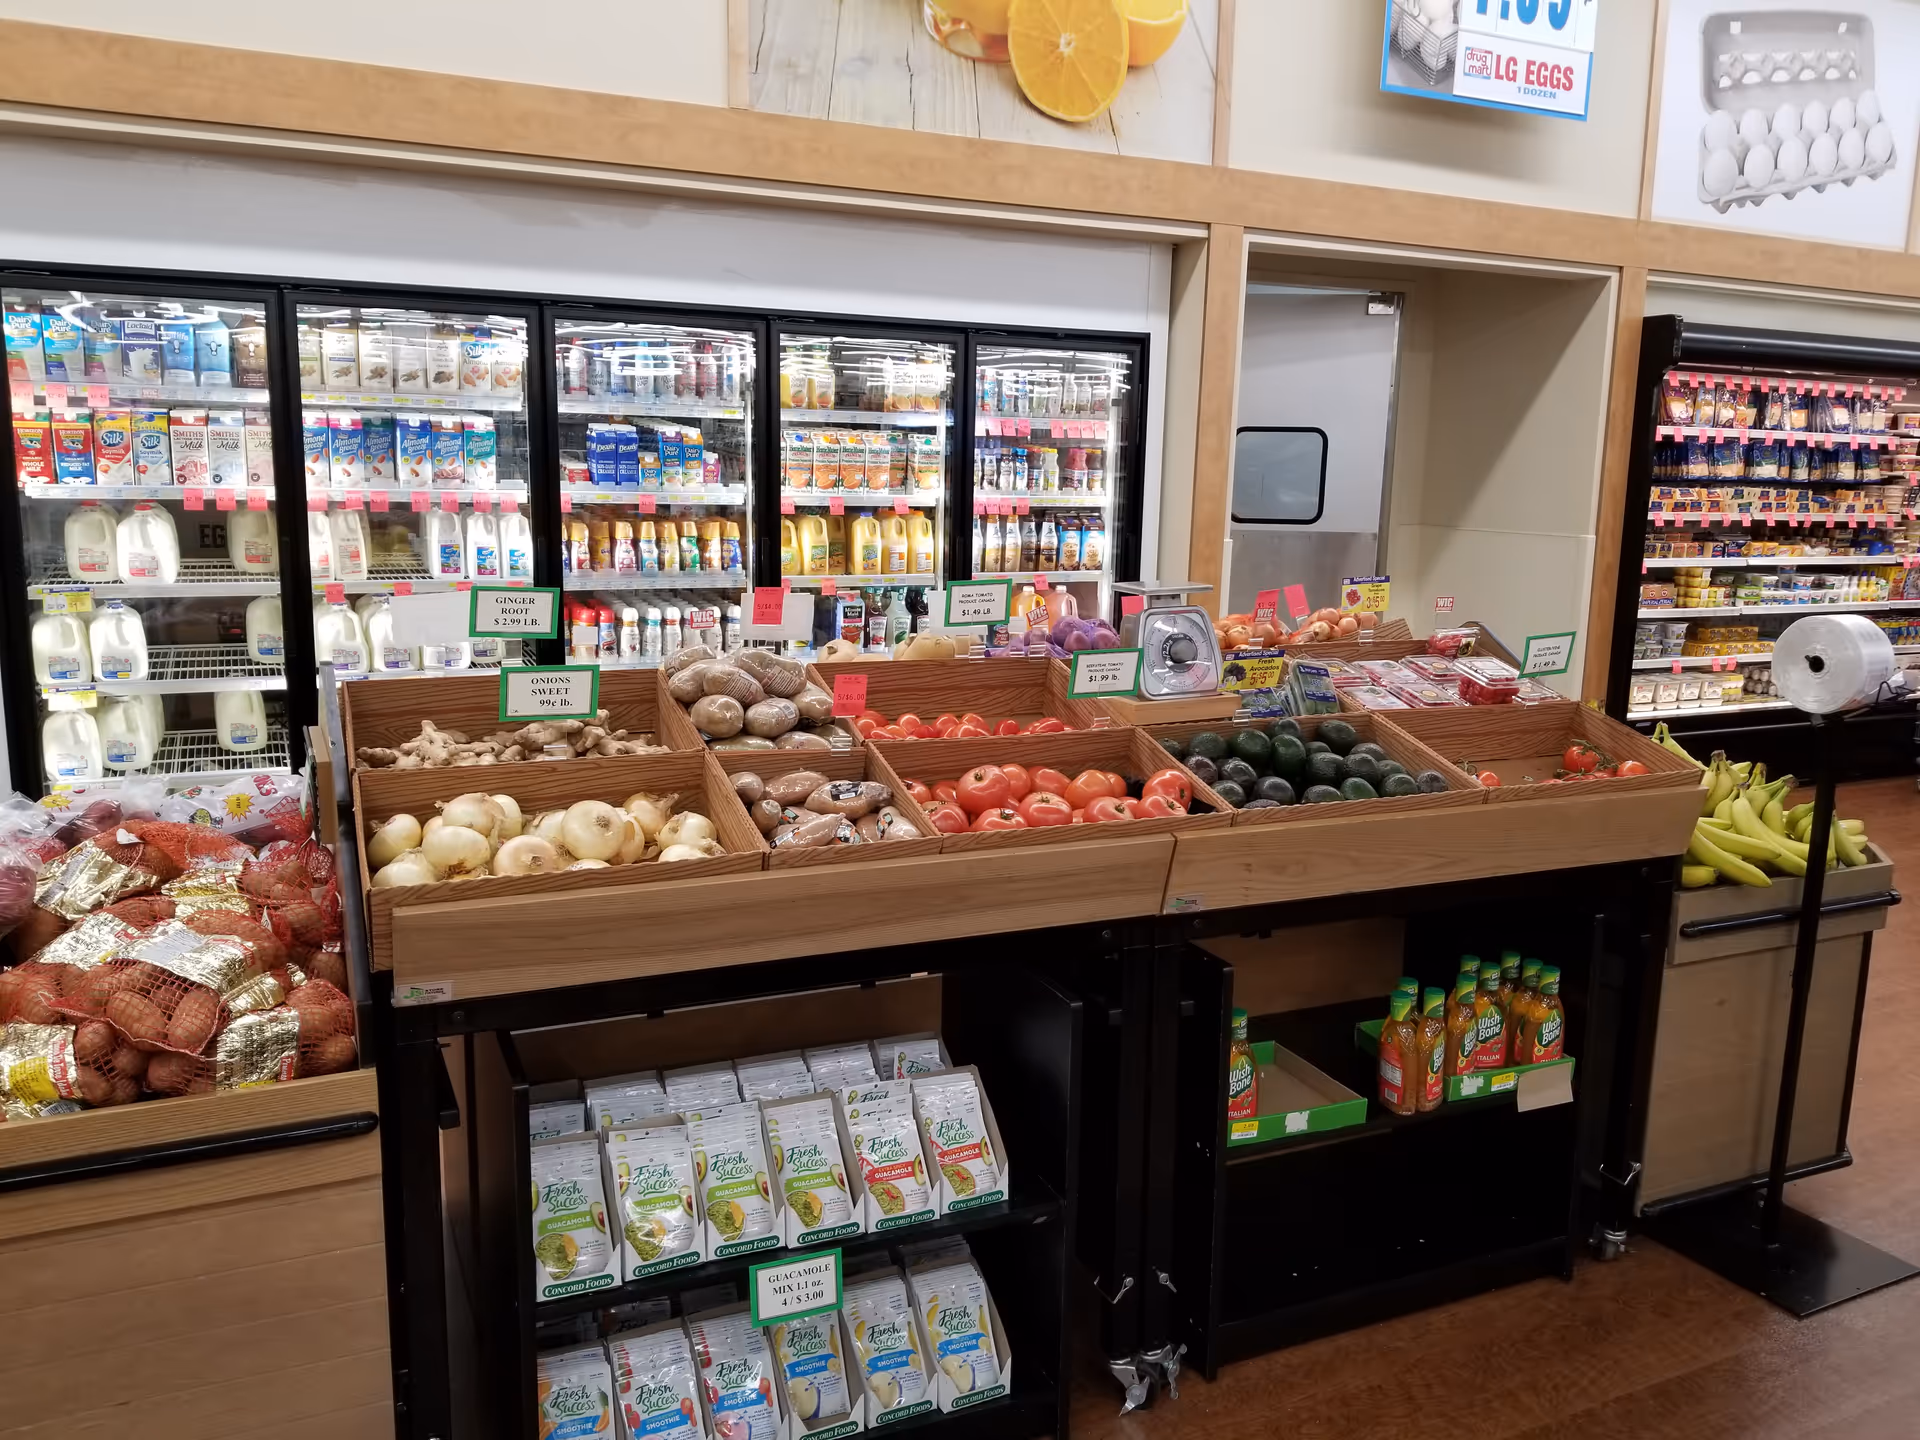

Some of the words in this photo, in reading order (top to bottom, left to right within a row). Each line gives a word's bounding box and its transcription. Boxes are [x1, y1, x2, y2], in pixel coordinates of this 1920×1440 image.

[1466, 49, 1488, 65] drug
[1468, 63, 1491, 75] mart
[1495, 55, 1518, 82] LG
[1525, 60, 1574, 91] EGGS
[1523, 87, 1557, 99] DOZEN
[9, 315, 33, 325] Dairy
[11, 322, 31, 330] Pure
[49, 318, 72, 329] Dairy
[102, 430, 124, 446] Silk
[173, 430, 204, 438] SMITH'S
[210, 430, 240, 438] SMITH'S
[140, 435, 161, 449] Silk
[180, 440, 204, 451] Milk
[217, 441, 241, 451] Milk
[333, 435, 361, 448] Almond
[339, 443, 359, 454] Breeze
[402, 435, 429, 449] Almond
[435, 437, 462, 450] Almond
[467, 438, 494, 451] Almond
[407, 443, 427, 455] Breeze
[441, 445, 460, 456] Breeze
[472, 446, 492, 456] Breeze
[495, 597, 535, 605] GINGER
[1437, 597, 1453, 607] WIC
[501, 607, 530, 615] ROOT
[691, 611, 715, 622] WIC
[1027, 606, 1047, 621] WIC
[1257, 608, 1273, 618] WIC
[502, 618, 521, 626] 2.99
[523, 618, 540, 626] LB.
[1249, 665, 1280, 673] Avocados
[531, 676, 571, 685] ONIONS
[1088, 674, 1109, 683] $1.99
[531, 688, 571, 696] SWEET
[560, 698, 573, 707] lb.
[1478, 1023, 1500, 1040] Bone
[1542, 1028, 1561, 1045] Bone
[1229, 1075, 1251, 1096] Bone
[1228, 1108, 1251, 1117] ITALIAN
[936, 1118, 968, 1137] Fresh
[867, 1134, 903, 1153] Fresh
[942, 1129, 975, 1145] Success
[786, 1144, 823, 1163] Fresh
[874, 1146, 908, 1162] Success
[944, 1149, 981, 1161] GUACAMOLE
[710, 1151, 748, 1171] Fresh
[792, 1157, 828, 1172] Success
[633, 1163, 673, 1184] Fresh
[716, 1165, 753, 1181] Success
[874, 1167, 913, 1179] GUACAMOLE
[638, 1178, 679, 1195] Success
[793, 1175, 832, 1187] GUACAMOLE
[542, 1181, 583, 1203] Fresh
[715, 1184, 756, 1196] GUACAMOLE
[548, 1195, 589, 1211] Success
[950, 1197, 981, 1210] CONCORD
[981, 1192, 1003, 1204] FOODS
[547, 1215, 592, 1229] GUACAMOLE
[877, 1216, 910, 1229] CONCORD
[910, 1211, 934, 1223] FOODS
[799, 1230, 835, 1243] CONCORD
[834, 1224, 858, 1236] FOODS
[716, 1244, 753, 1256] CONCORD
[753, 1238, 778, 1249] FOODS
[634, 1262, 673, 1276] CONCORD
[672, 1253, 699, 1267] FOODS
[768, 1263, 831, 1283] GUACAMOLE
[544, 1282, 584, 1297] CONCORD
[584, 1276, 613, 1289] FOODS
[772, 1284, 794, 1296] MIX
[797, 1281, 808, 1291] 1.1
[811, 1279, 824, 1287] oz.
[804, 1290, 824, 1303] 3.00
[939, 1305, 972, 1327] Fresh
[867, 1322, 901, 1343] Fresh
[944, 1319, 976, 1335] Success
[787, 1325, 824, 1348] Fresh
[873, 1335, 906, 1351] Success
[792, 1339, 827, 1356] Success
[947, 1338, 977, 1351] SMOOTHIE
[795, 1360, 826, 1373] SMOOTHIE
[877, 1355, 908, 1368] SMOOTHIE
[716, 1358, 753, 1381] Fresh
[550, 1385, 592, 1408] Fresh
[635, 1383, 675, 1407] Fresh
[724, 1394, 757, 1407] SMOOTHIE
[953, 1393, 983, 1408] CONCORD
[983, 1386, 1005, 1399] FOODS
[555, 1399, 596, 1418] Success
[641, 1393, 680, 1414] Success
[878, 1408, 909, 1424] CONCORD
[909, 1401, 932, 1414] FOODS
[556, 1423, 593, 1436] SMOOTHIE
[646, 1415, 681, 1431] SMOOTHIE
[834, 1422, 857, 1436] FOODS
